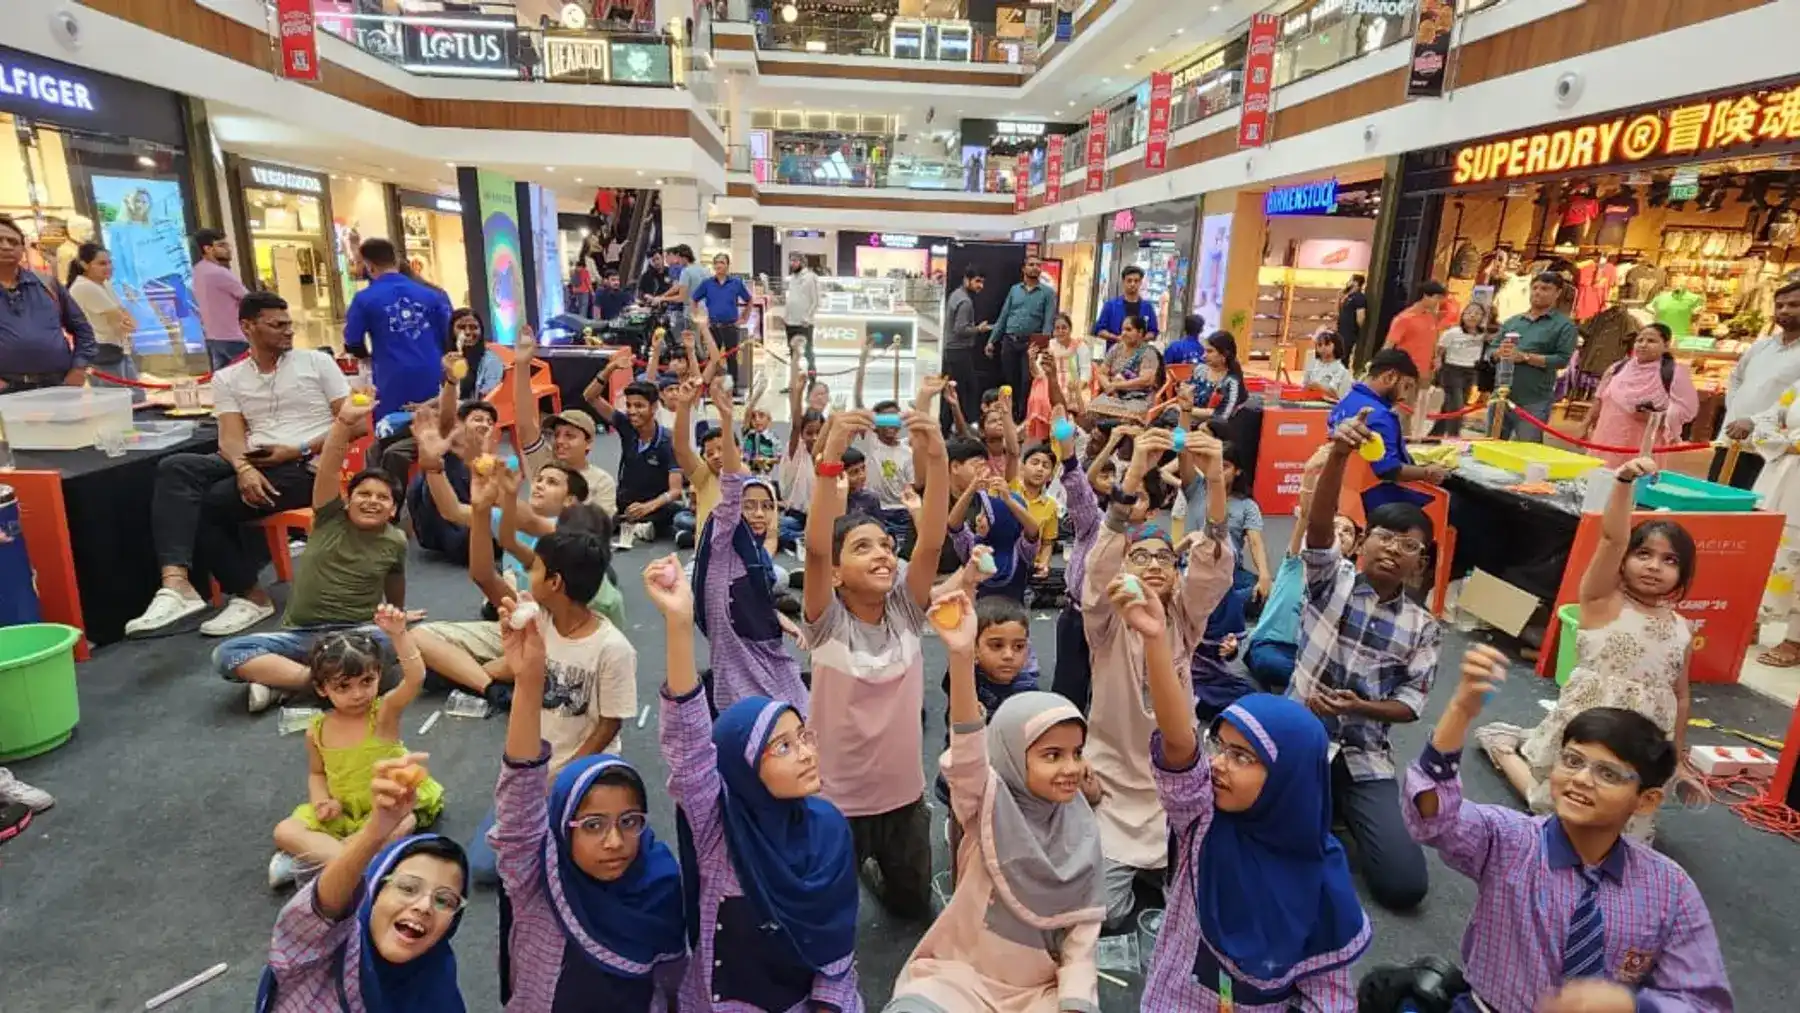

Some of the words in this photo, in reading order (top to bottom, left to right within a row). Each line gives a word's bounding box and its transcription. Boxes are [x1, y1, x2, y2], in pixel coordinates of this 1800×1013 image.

[419, 31, 501, 62] LOTUS
[551, 43, 601, 76] BEARDO
[0, 63, 95, 111] LFIGER
[813, 327, 857, 340] MARS
